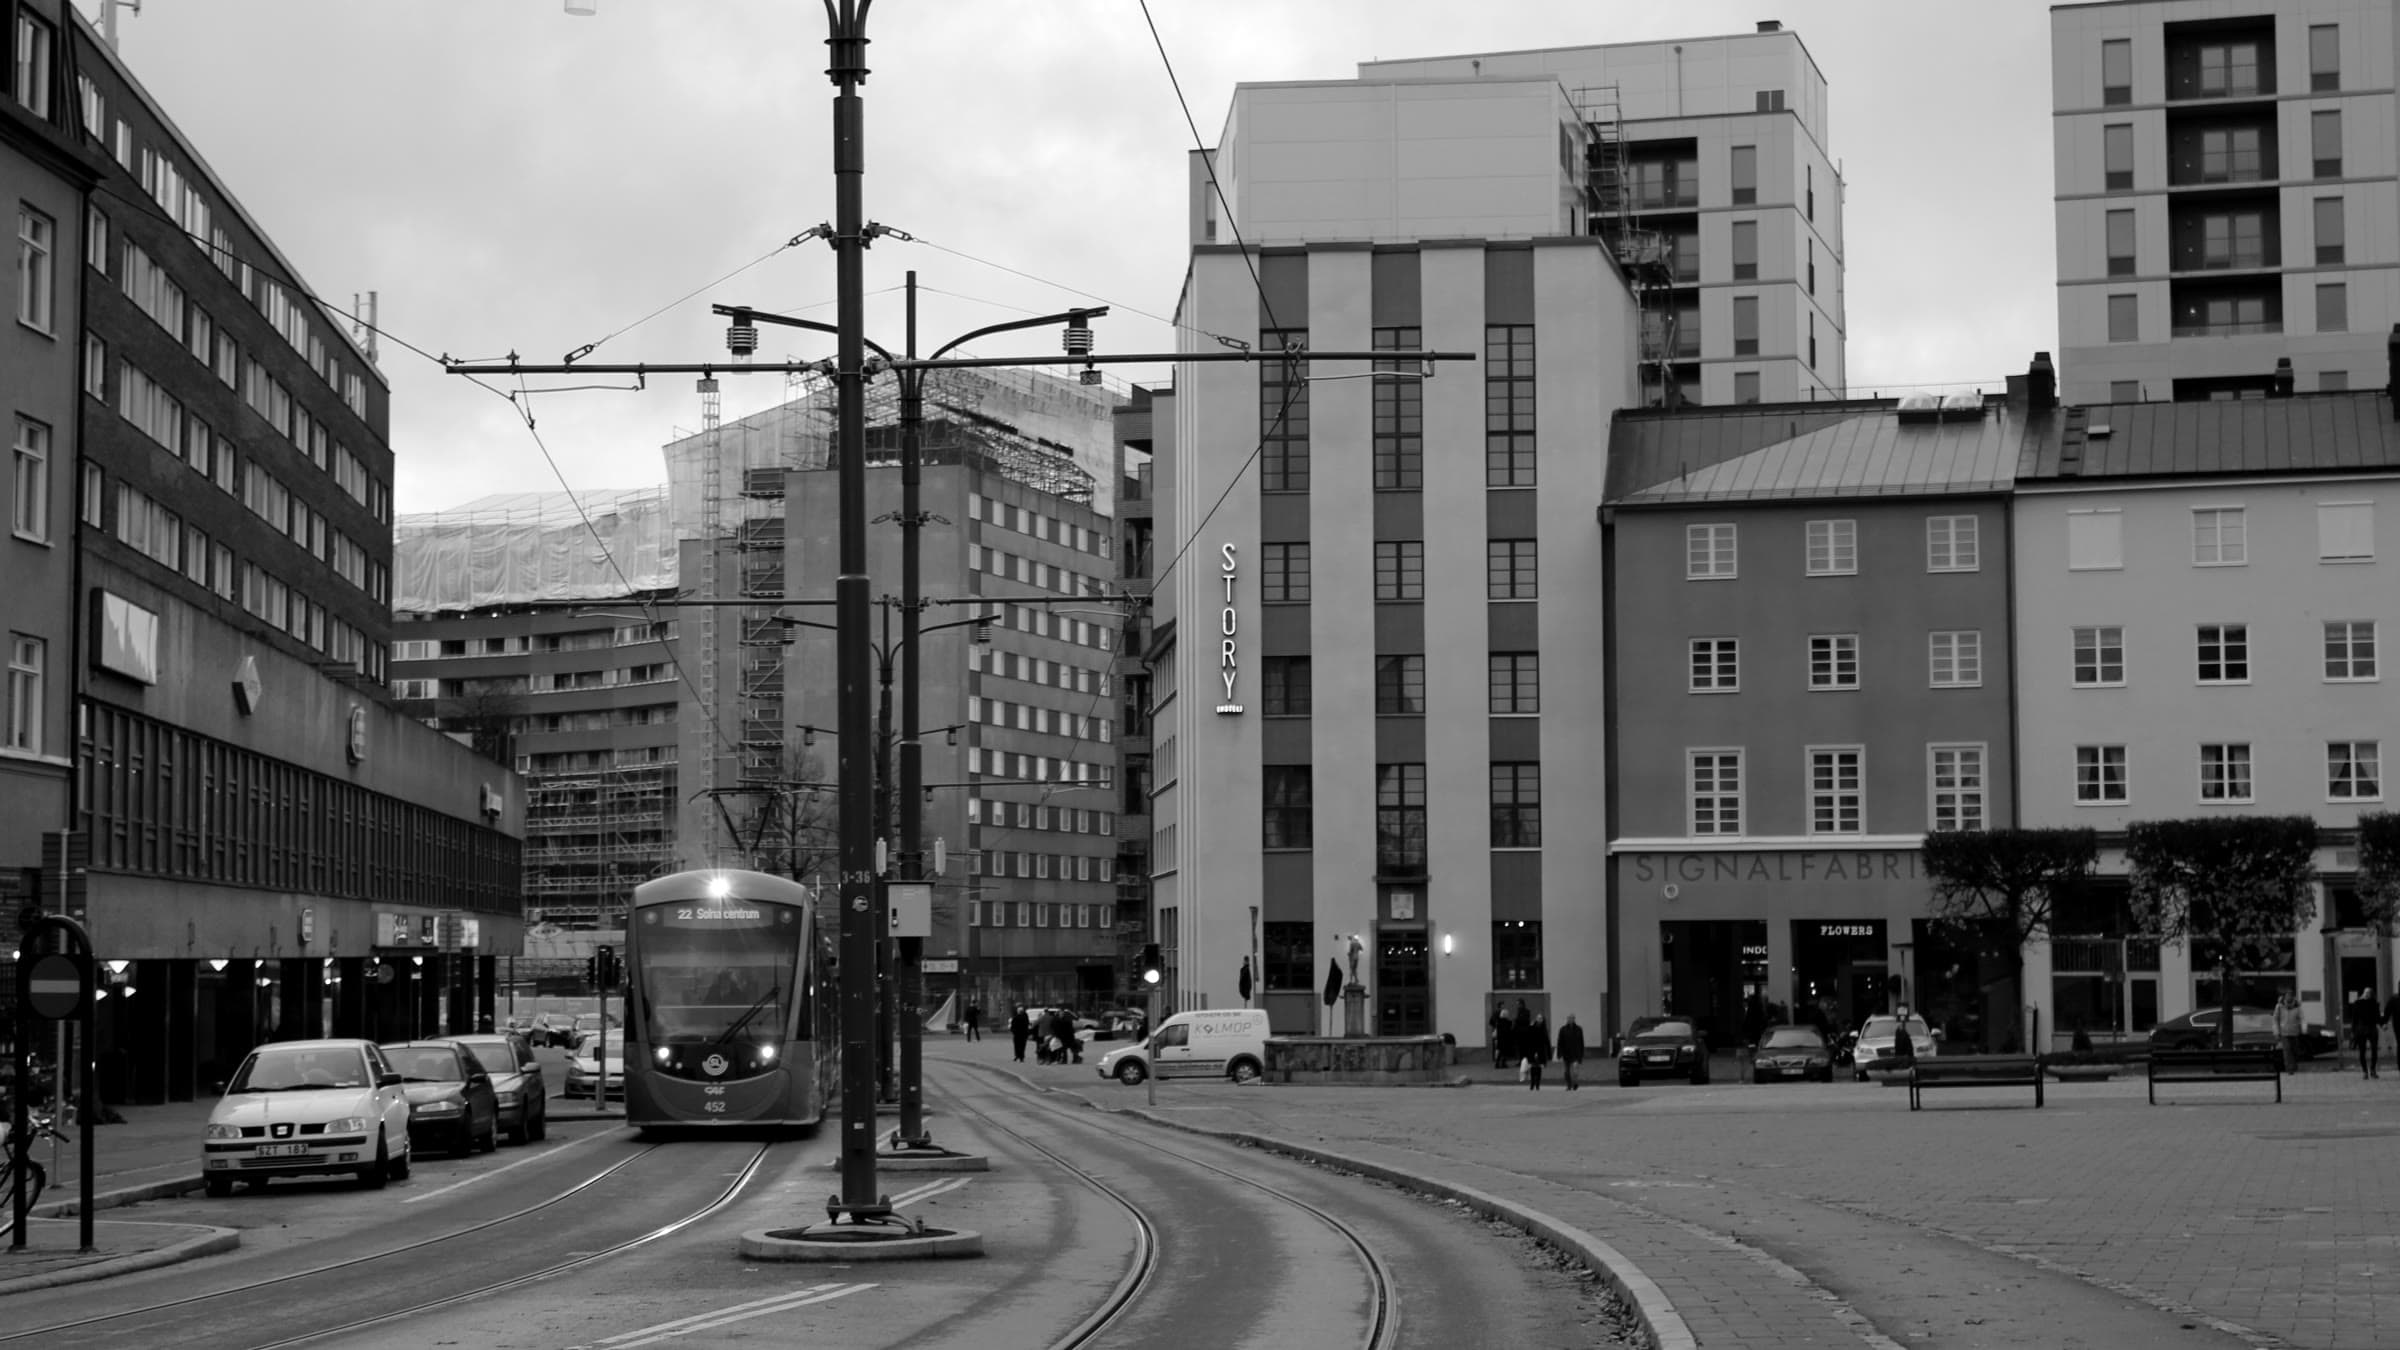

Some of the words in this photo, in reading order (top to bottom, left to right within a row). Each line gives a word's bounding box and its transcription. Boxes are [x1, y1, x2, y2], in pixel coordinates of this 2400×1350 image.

[1222, 543, 1236, 699] STORY
[1635, 852, 1926, 882] SIGNALFABRI
[677, 908, 693, 920] 22
[696, 907, 722, 920] Solna
[723, 908, 760, 919] centrum
[1820, 925, 1873, 936] FLOWERS
[704, 1101, 727, 1113] 452
